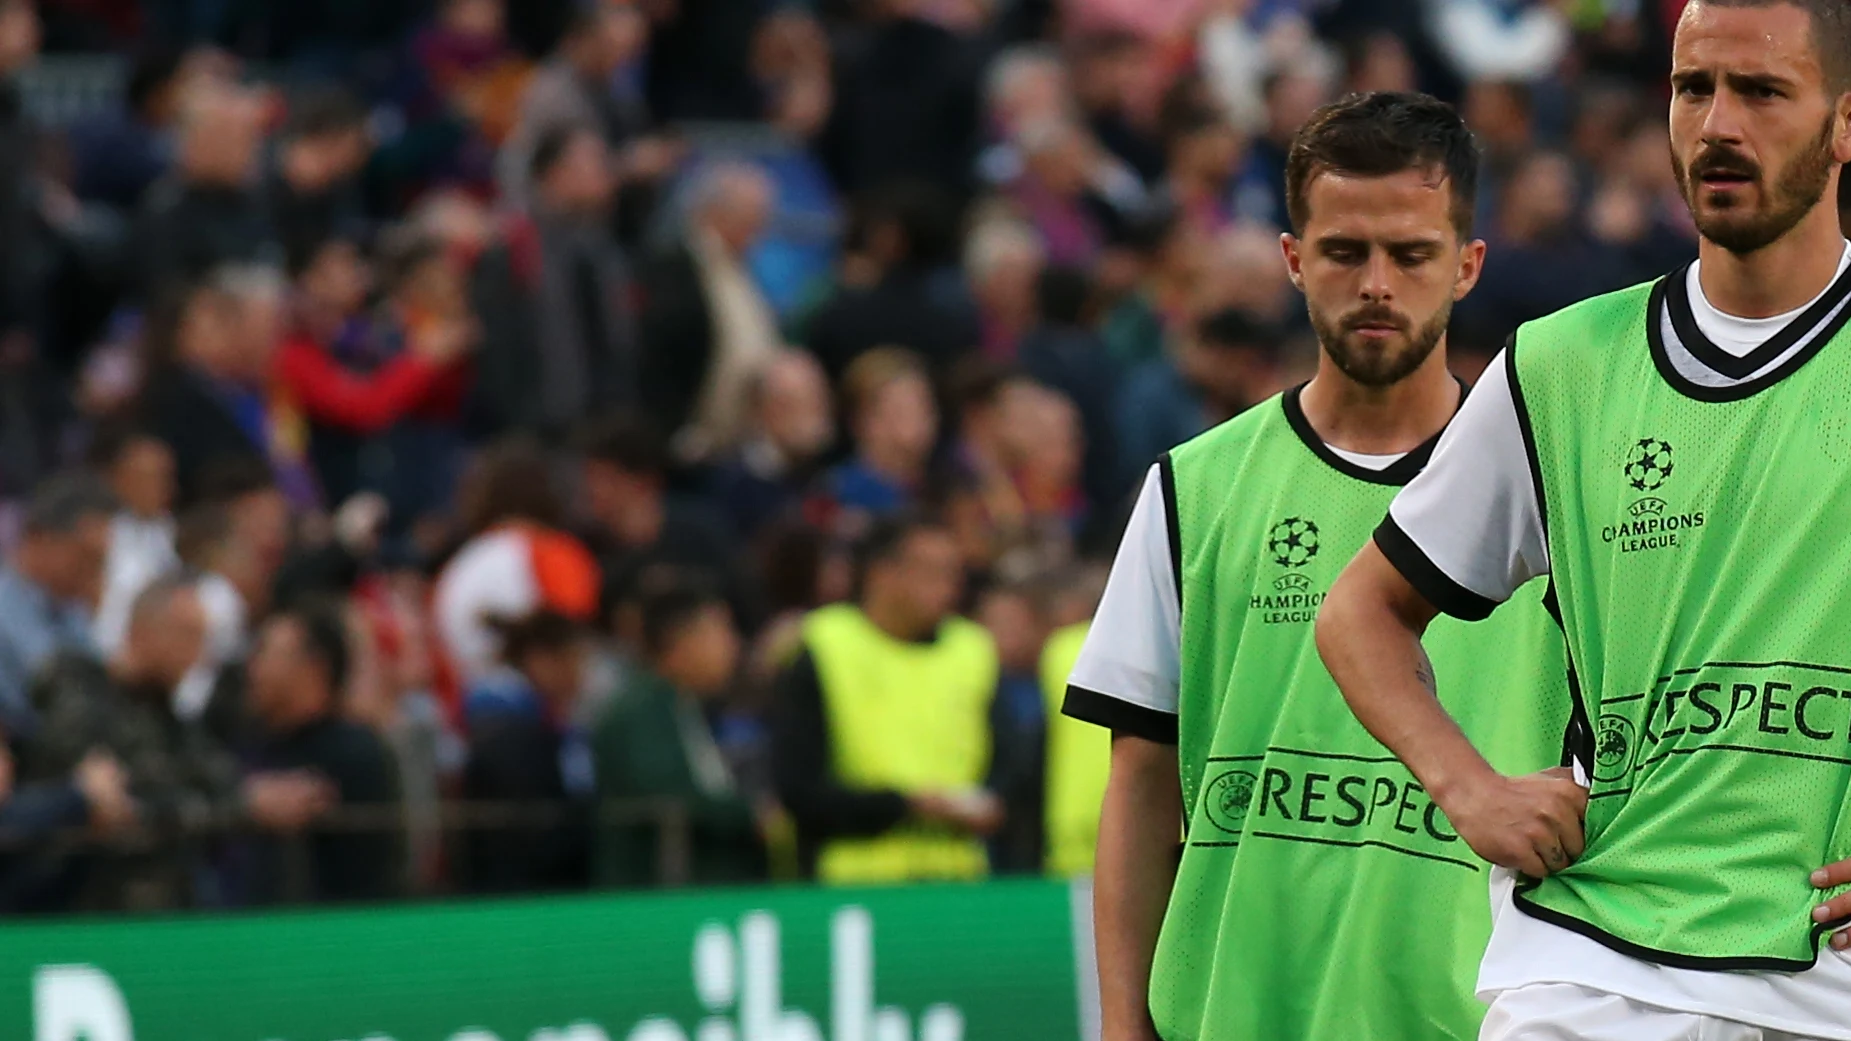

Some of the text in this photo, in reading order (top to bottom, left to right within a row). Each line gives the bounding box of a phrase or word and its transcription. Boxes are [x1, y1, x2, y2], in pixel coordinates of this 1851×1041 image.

[1630, 500, 1663, 517] UEFA
[1621, 534, 1677, 552] LEAGUE
[1273, 576, 1309, 590] UEFA
